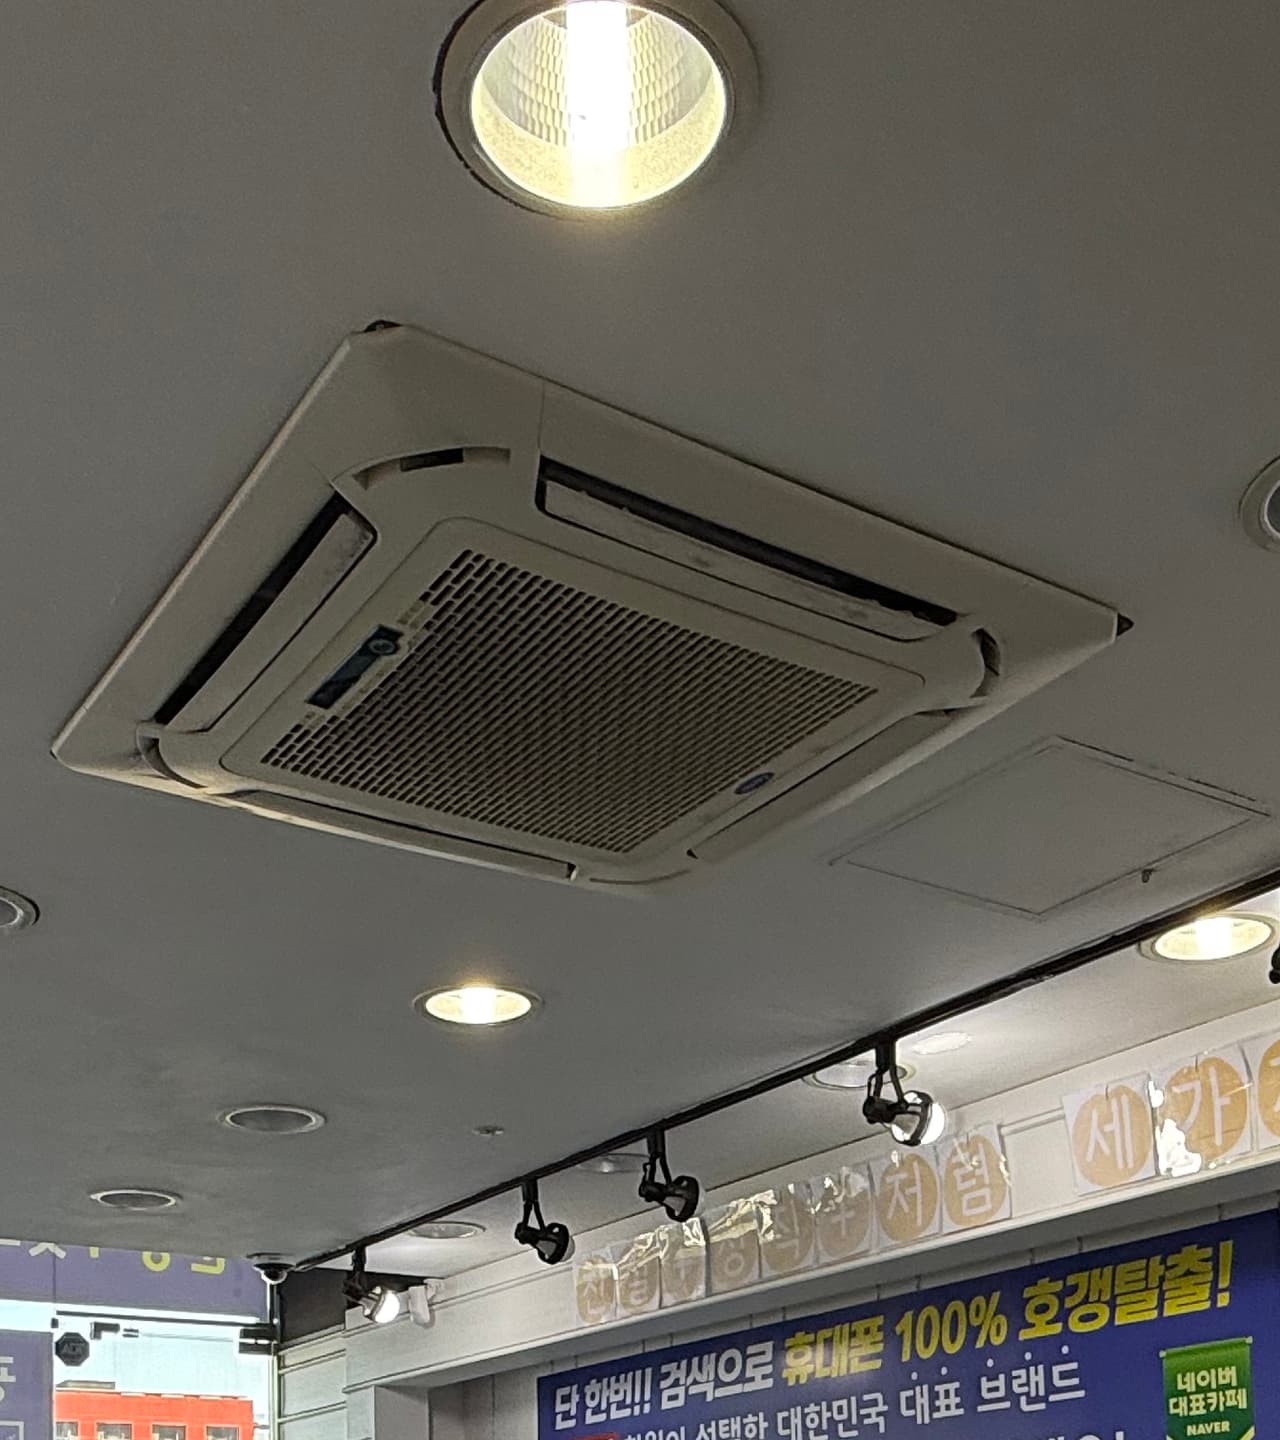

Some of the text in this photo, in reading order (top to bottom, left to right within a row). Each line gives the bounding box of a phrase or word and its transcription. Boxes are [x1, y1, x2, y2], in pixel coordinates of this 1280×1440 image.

[554, 1241, 1233, 1430] 단 한번!! 검색으로 휴대폰 100% 호갱탈출!
[900, 1379, 965, 1424] 대표
[976, 1361, 1087, 1414] 브랜드
[1177, 1366, 1237, 1392] 네이버
[1169, 1388, 1247, 1417] 대표카페
[1187, 1421, 1230, 1437] NAVER
